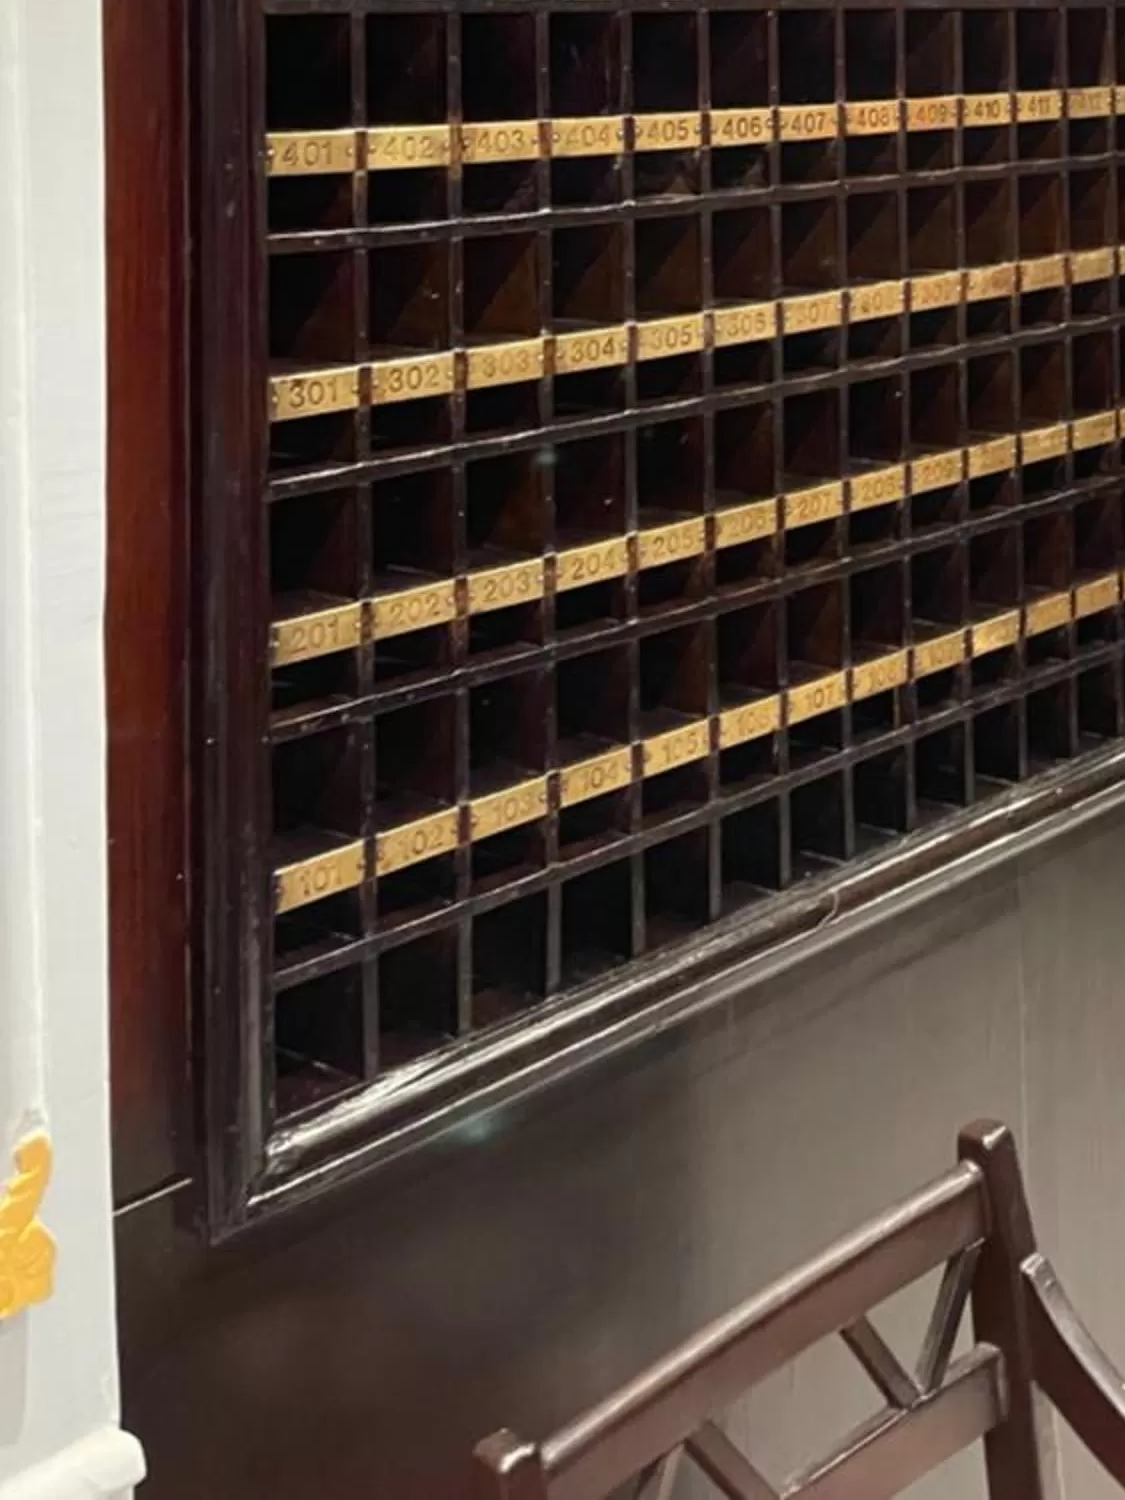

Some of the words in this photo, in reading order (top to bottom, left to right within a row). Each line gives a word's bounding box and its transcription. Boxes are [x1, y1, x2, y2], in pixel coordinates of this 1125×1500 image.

[649, 119, 689, 142] 405
[723, 116, 761, 139] 406
[790, 111, 826, 133] 407
[383, 135, 433, 160] 402
[478, 129, 525, 153] 403
[565, 125, 611, 148] 404
[281, 140, 333, 167] 401
[727, 311, 766, 336] 306
[651, 324, 692, 350] 305
[482, 345, 530, 378] 303
[570, 337, 614, 364] 304
[388, 363, 440, 393] 302
[288, 378, 338, 410] 301
[797, 493, 832, 516] 207
[651, 531, 694, 557] 205
[572, 547, 616, 580] 204
[484, 569, 531, 602] 203
[389, 592, 441, 621] 202
[292, 615, 339, 650] 201
[300, 860, 342, 896] 101
